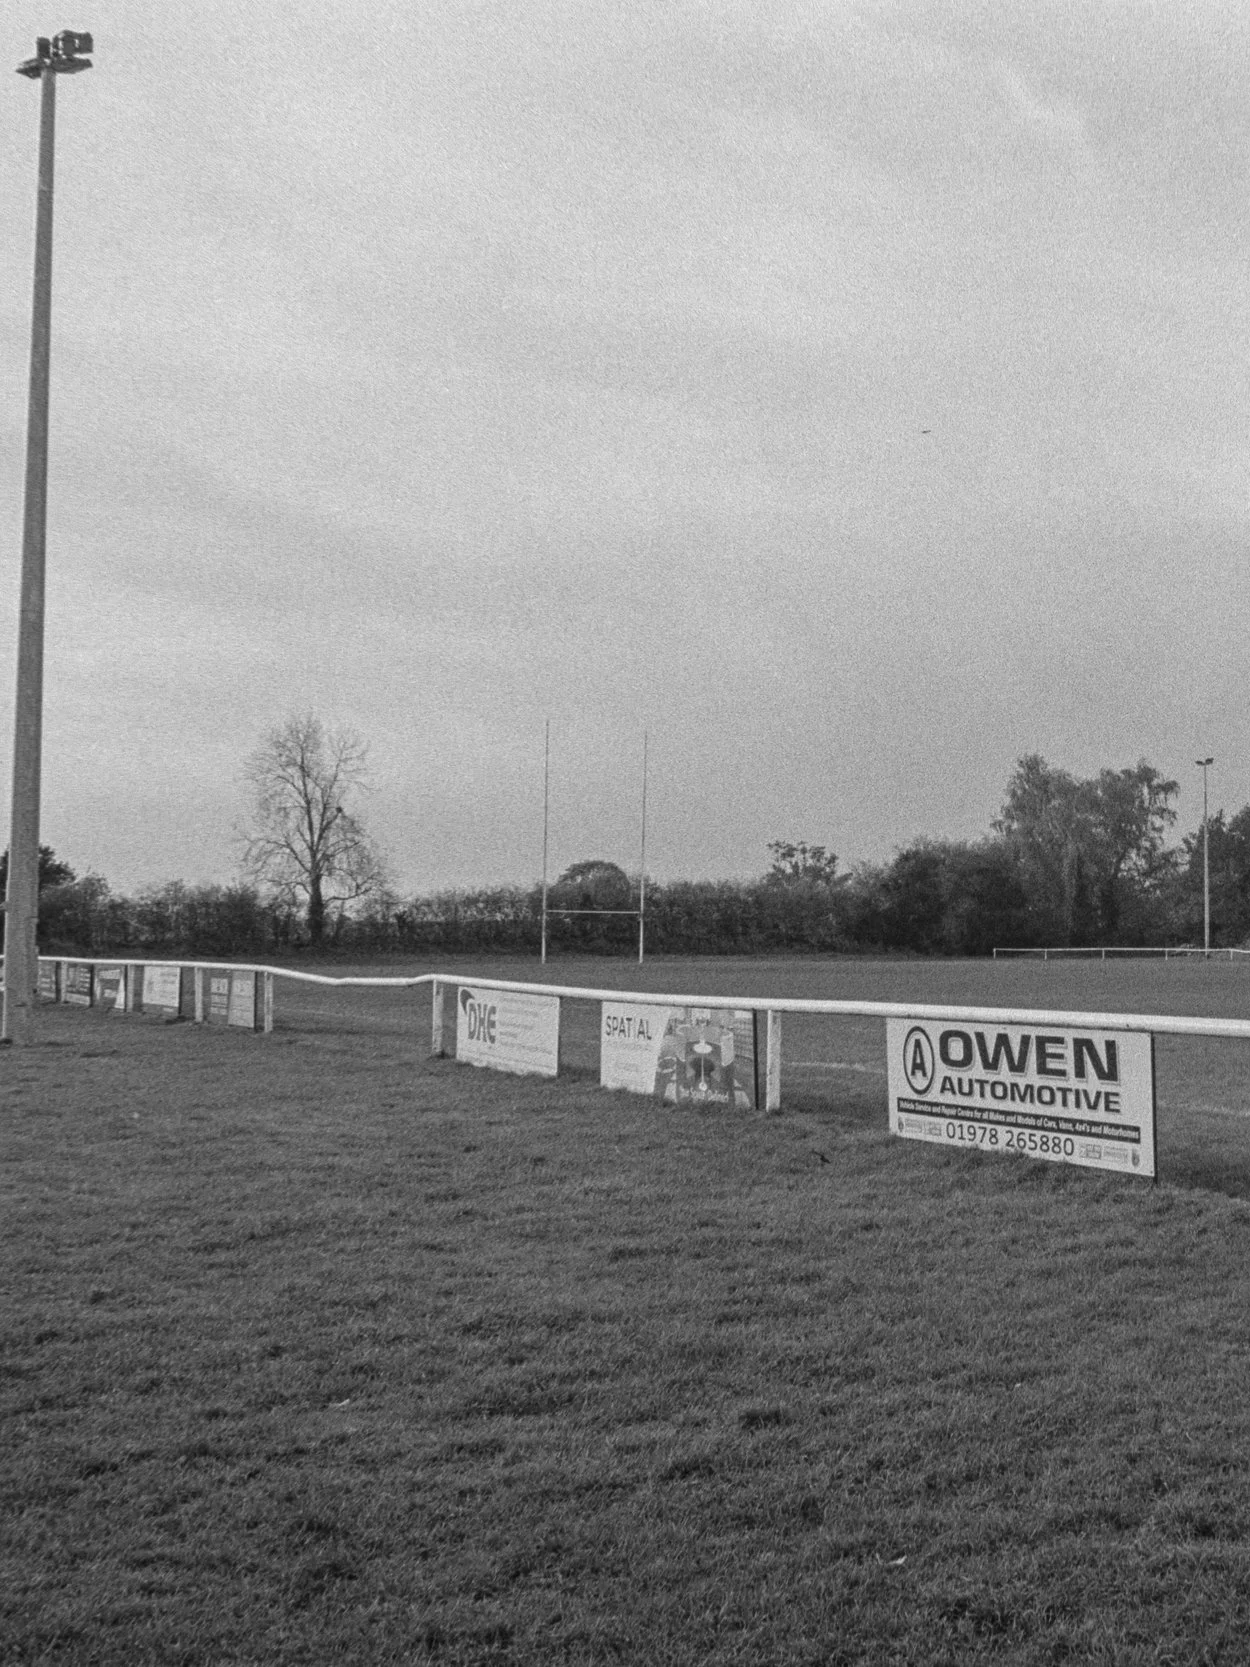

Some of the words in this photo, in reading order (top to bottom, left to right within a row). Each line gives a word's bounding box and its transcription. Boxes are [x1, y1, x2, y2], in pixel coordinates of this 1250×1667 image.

[910, 1038, 928, 1078] A
[938, 1029, 1119, 1082] OWEN
[939, 1075, 1121, 1113] AUTOMOTIVE
[915, 1102, 931, 1112] Service
[932, 1105, 941, 1113] and
[941, 1105, 957, 1116] Repair
[974, 1109, 982, 1119] for
[989, 1111, 1006, 1121] Makes
[1006, 1113, 1016, 1122] and
[1017, 1115, 1036, 1126] Models
[1037, 1117, 1043, 1127] of
[1043, 1118, 1058, 1129] Cars,
[1059, 1120, 1074, 1131] Vans,
[1091, 1124, 1102, 1134] and
[1103, 1124, 1140, 1139] Motorhomes
[946, 1121, 999, 1145] 01978
[1005, 1129, 1075, 1156] 265880
